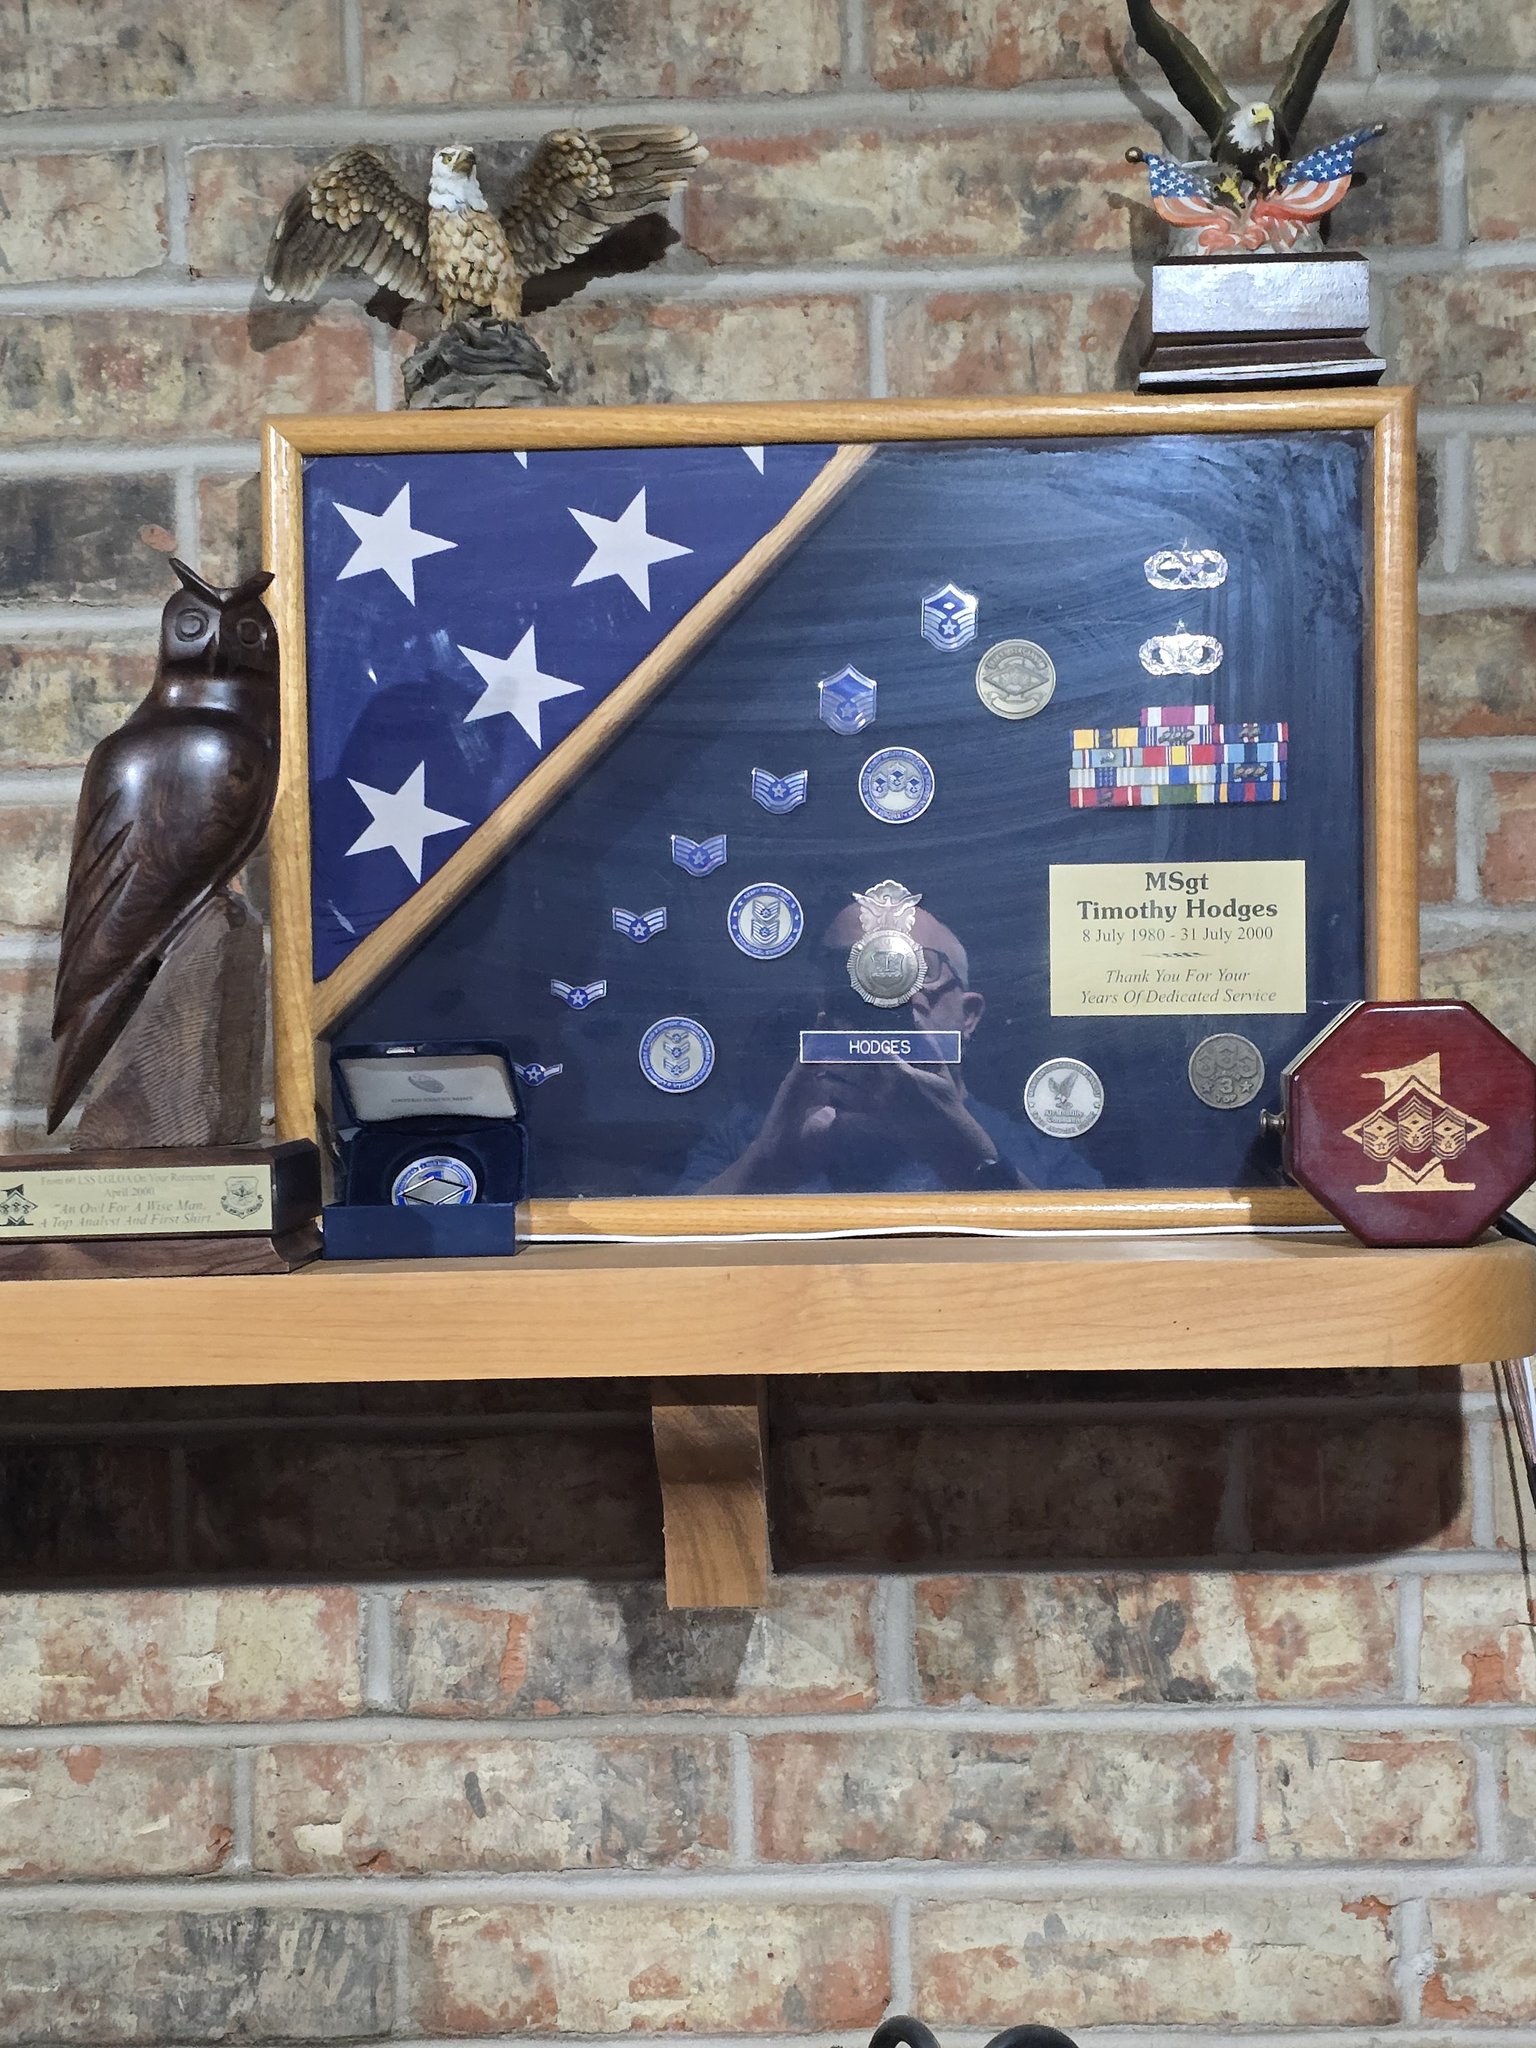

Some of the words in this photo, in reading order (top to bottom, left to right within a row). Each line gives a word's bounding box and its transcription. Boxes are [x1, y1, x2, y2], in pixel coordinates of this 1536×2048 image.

[1145, 871, 1209, 894] MSgt
[1077, 899, 1177, 922] Timothy
[1186, 898, 1278, 922] Hodges
[1082, 930, 1091, 942] 8
[1096, 928, 1125, 945] July
[1131, 928, 1165, 942] 1980
[1180, 928, 1197, 941] 31
[1203, 927, 1232, 944] July
[1238, 926, 1273, 940] 2000
[1106, 969, 1149, 984] Thank
[1156, 969, 1181, 983] You
[1186, 968, 1212, 982] For
[1218, 968, 1251, 982] Your
[1081, 990, 1118, 1005] Years
[1124, 989, 1145, 1007] Of
[1146, 989, 1219, 1004] Dedicated
[1223, 988, 1277, 1002] Service
[849, 1040, 911, 1055] HODGES
[1219, 1078, 1234, 1094] 3
[80, 1202, 105, 1214] Owl
[108, 1202, 130, 1213] For
[135, 1201, 142, 1212] A
[147, 1200, 173, 1211] Wise
[39, 1217, 47, 1228] A
[52, 1216, 73, 1230] Top
[80, 1215, 120, 1228] Analyst
[126, 1214, 149, 1225] And
[150, 1213, 180, 1225] First
